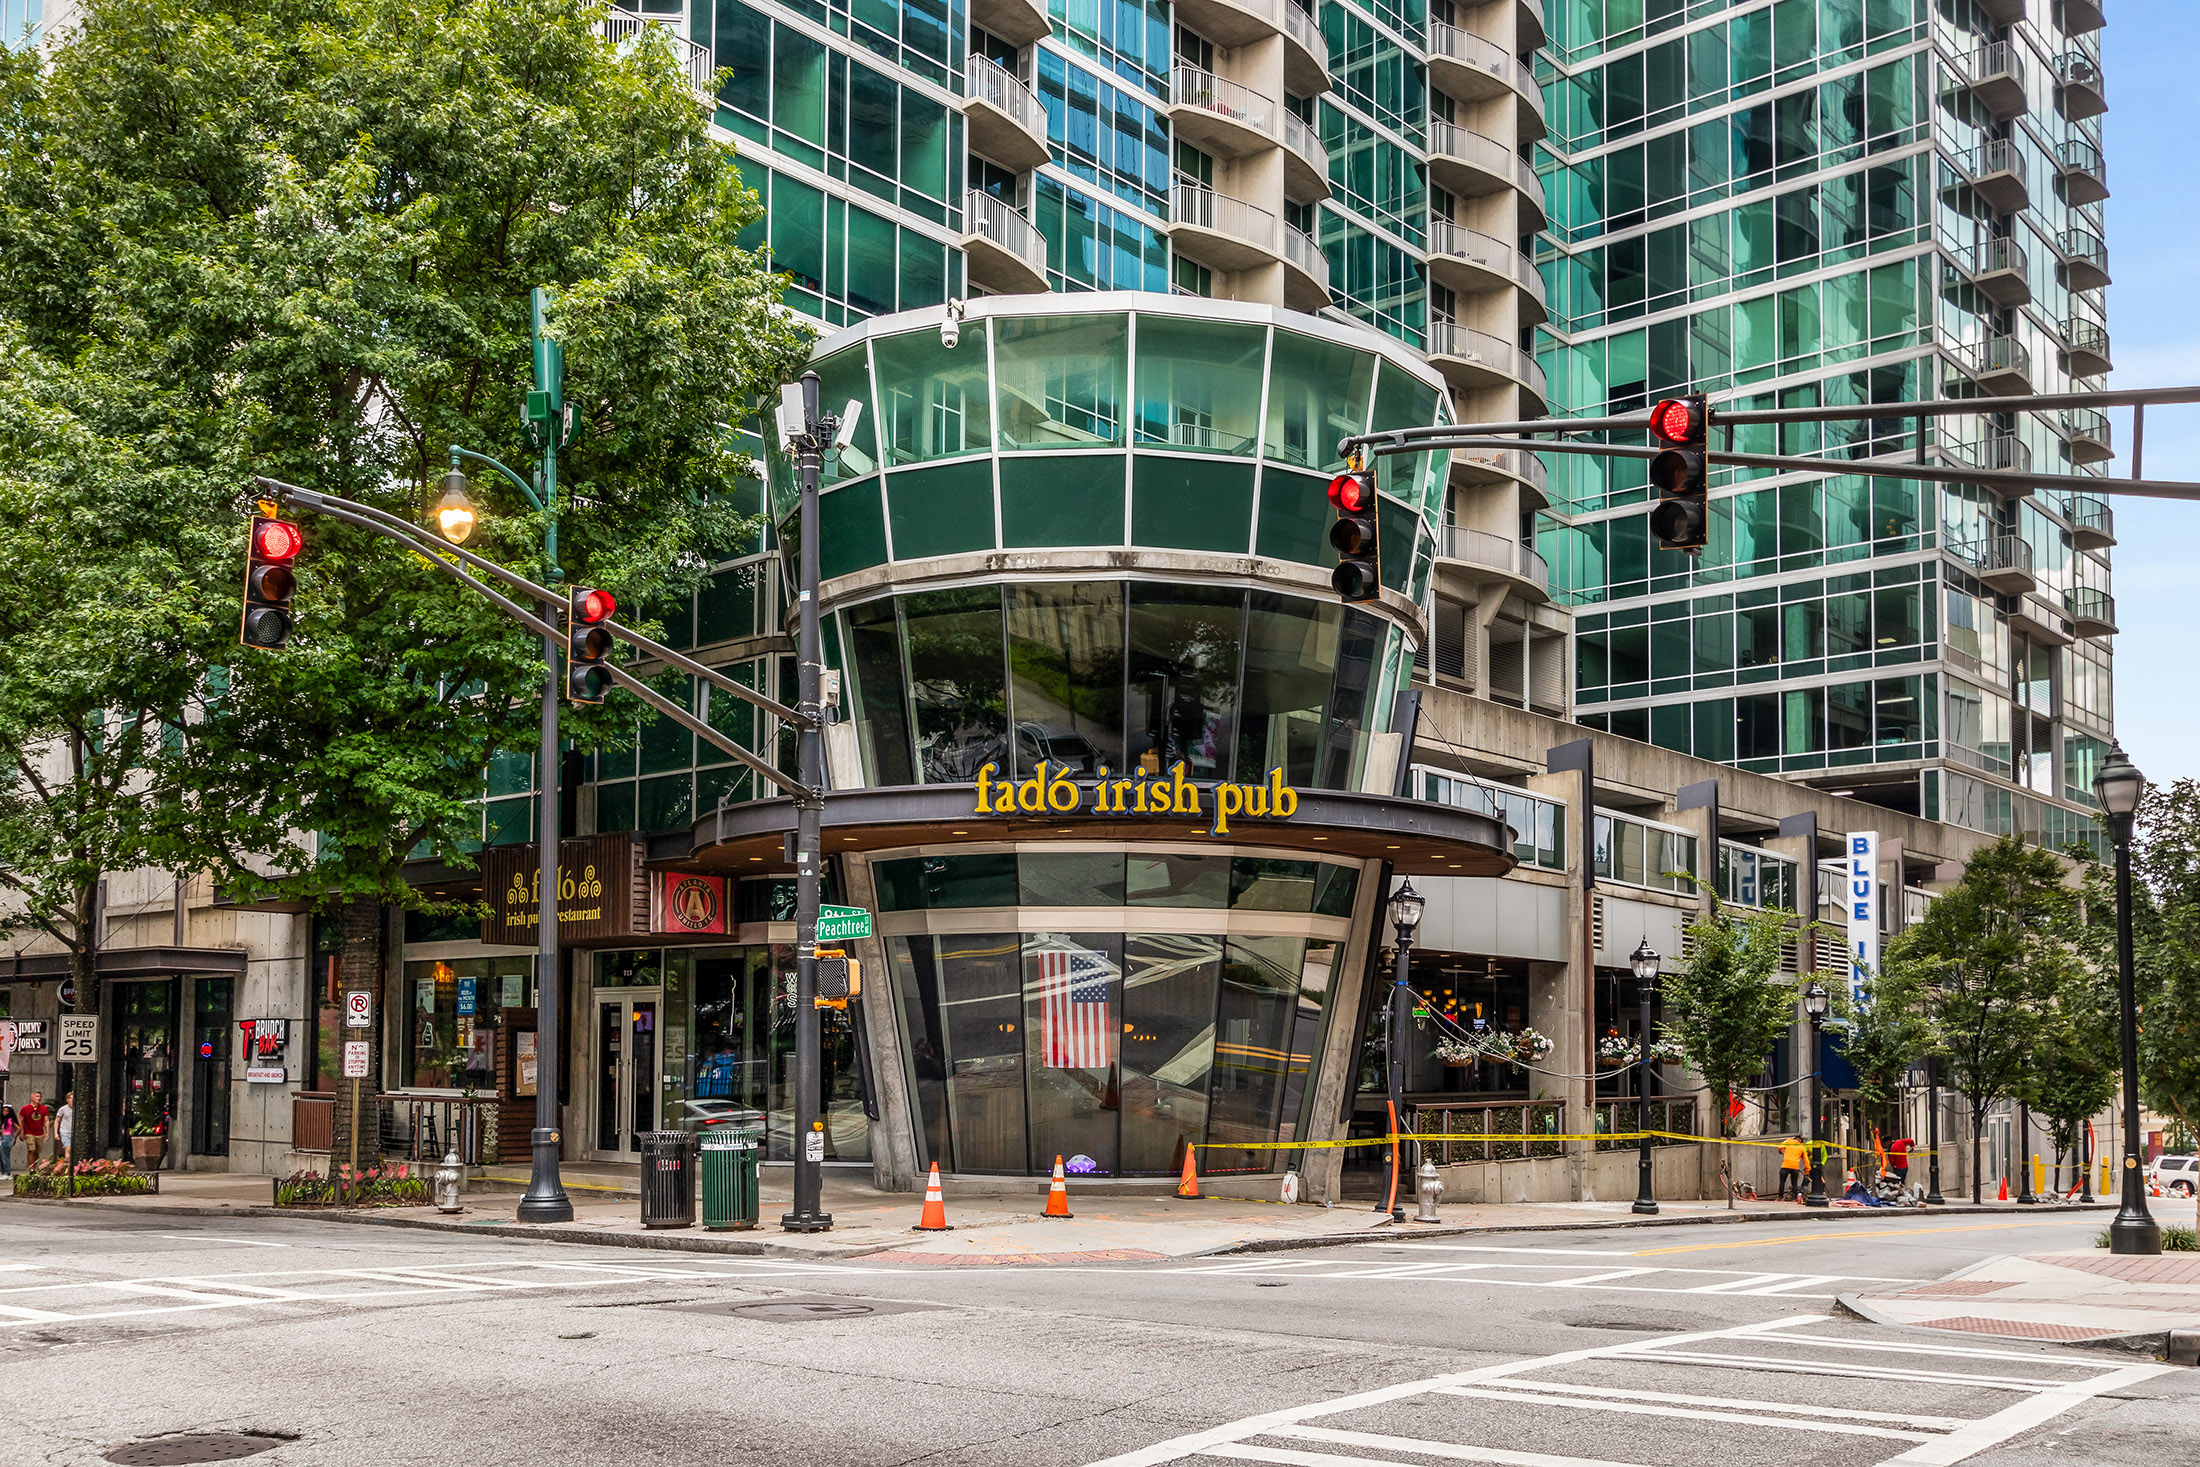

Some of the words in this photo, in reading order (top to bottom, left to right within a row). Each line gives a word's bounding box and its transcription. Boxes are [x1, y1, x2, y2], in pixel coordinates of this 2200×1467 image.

[973, 758, 1081, 815] fadó
[1093, 760, 1203, 815] irish
[1213, 766, 1299, 834] pub
[531, 865, 576, 903] fó
[679, 879, 711, 894] ATLANTA
[1851, 836, 1871, 921] BLUE
[686, 890, 706, 921] A
[506, 911, 526, 927] irish
[678, 913, 703, 929] UNITED
[704, 914, 713, 924] FC
[819, 919, 865, 937] Peachtree
[18, 1022, 41, 1037] JIMMY
[63, 1020, 95, 1028] SPEED
[255, 1019, 285, 1040] BRUNCH
[66, 1030, 91, 1038] LIMIT
[18, 1038, 41, 1052] JOHN'S
[63, 1039, 93, 1056] 25
[258, 1033, 278, 1055] BAR
